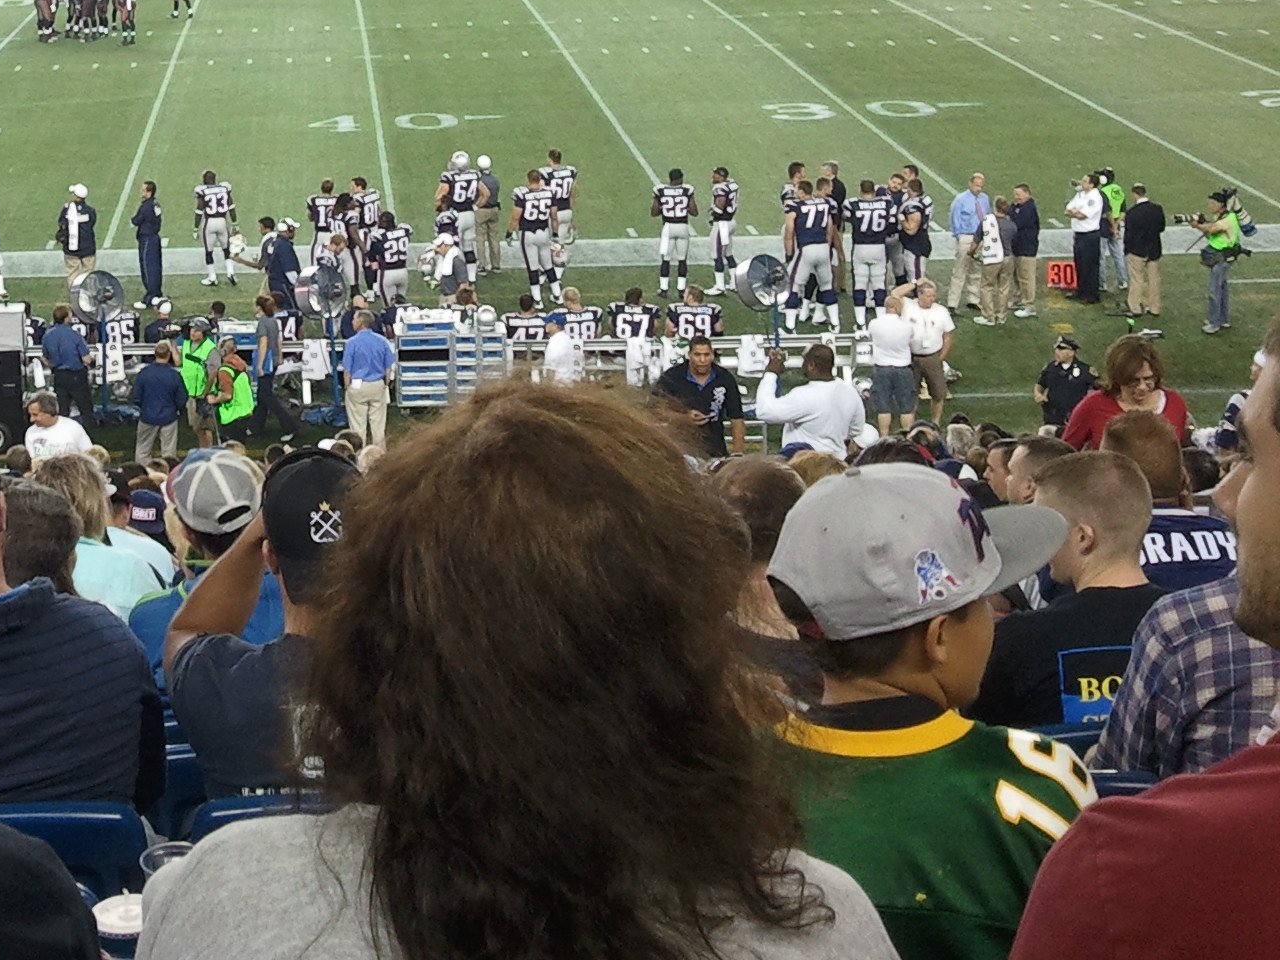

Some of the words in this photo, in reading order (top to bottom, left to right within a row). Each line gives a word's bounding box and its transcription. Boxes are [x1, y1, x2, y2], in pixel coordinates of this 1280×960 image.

[204, 192, 229, 214] 33
[453, 181, 478, 204] 64
[660, 196, 689, 218] 22
[800, 204, 830, 229] 77
[855, 209, 887, 233] 76
[1051, 263, 1075, 285] 30
[106, 319, 135, 345] 85
[615, 313, 651, 339] 67
[678, 313, 712, 340] 69
[1077, 674, 1124, 703] BO
